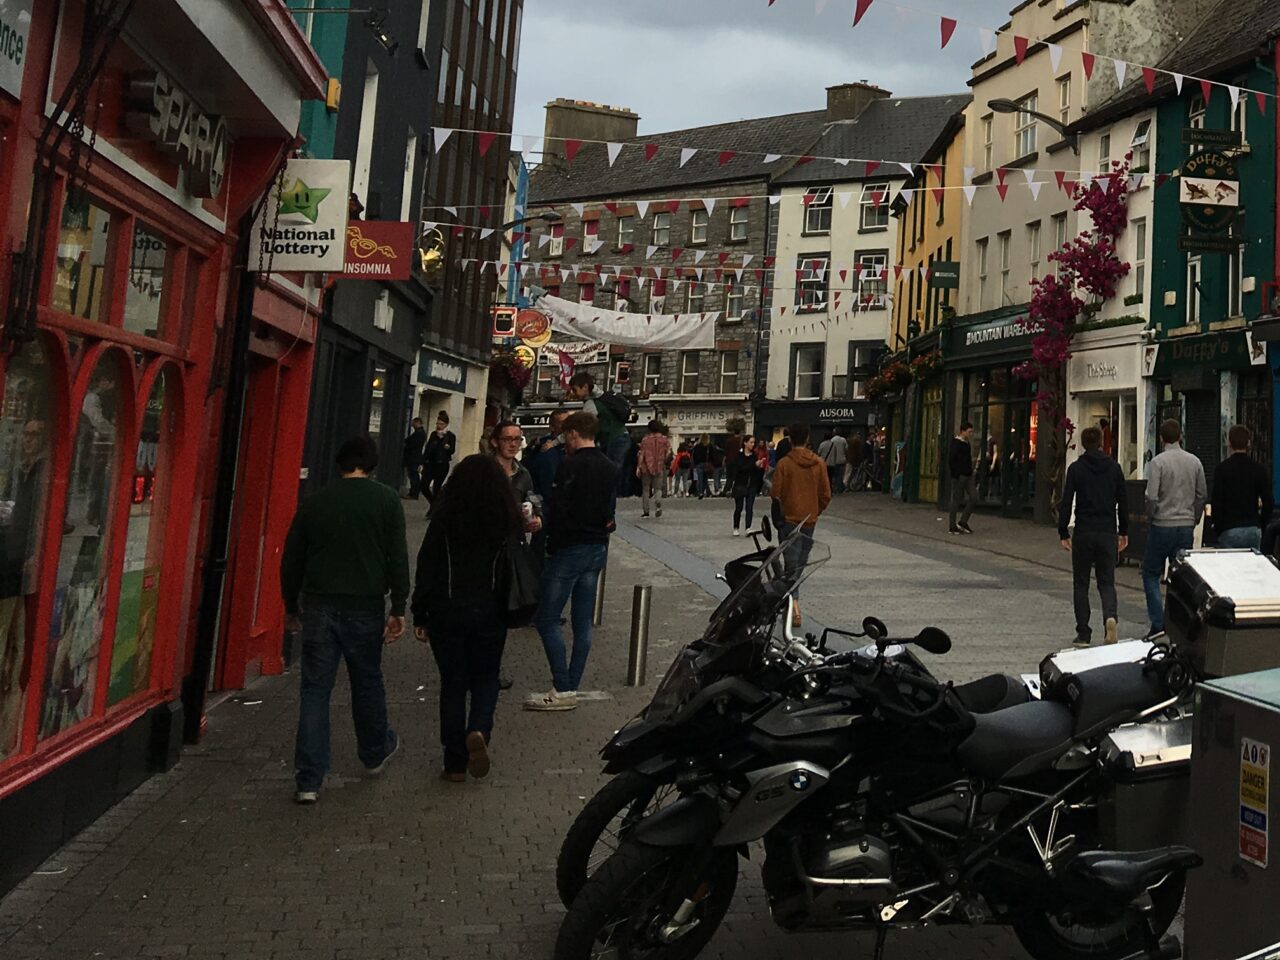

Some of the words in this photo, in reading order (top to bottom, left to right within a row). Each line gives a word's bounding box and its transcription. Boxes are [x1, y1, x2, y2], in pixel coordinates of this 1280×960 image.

[150, 70, 213, 173] SPAR
[260, 228, 335, 241] National
[264, 241, 329, 258] Lottery
[344, 262, 392, 275] INSOMNIA
[819, 408, 855, 418] AUSOBA
